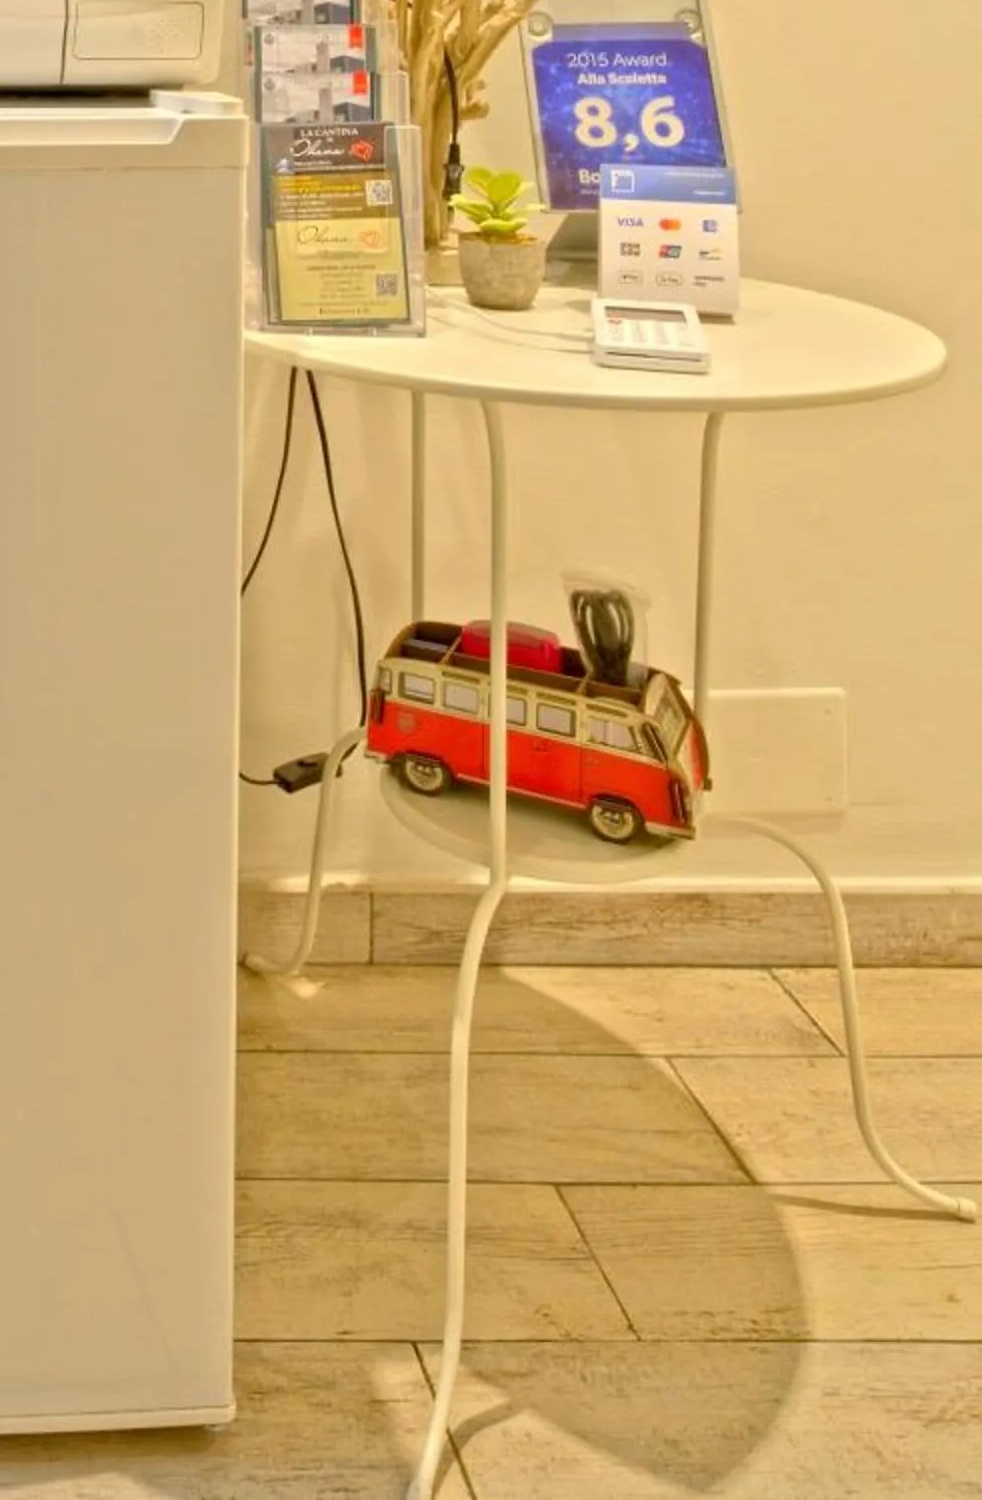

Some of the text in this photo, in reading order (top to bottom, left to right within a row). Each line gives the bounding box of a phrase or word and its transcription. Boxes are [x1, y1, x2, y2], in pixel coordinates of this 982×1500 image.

[566, 51, 668, 69] 2015 Award
[577, 71, 606, 86] Alla
[572, 94, 686, 156] 8,6
[616, 216, 645, 228] VISA
